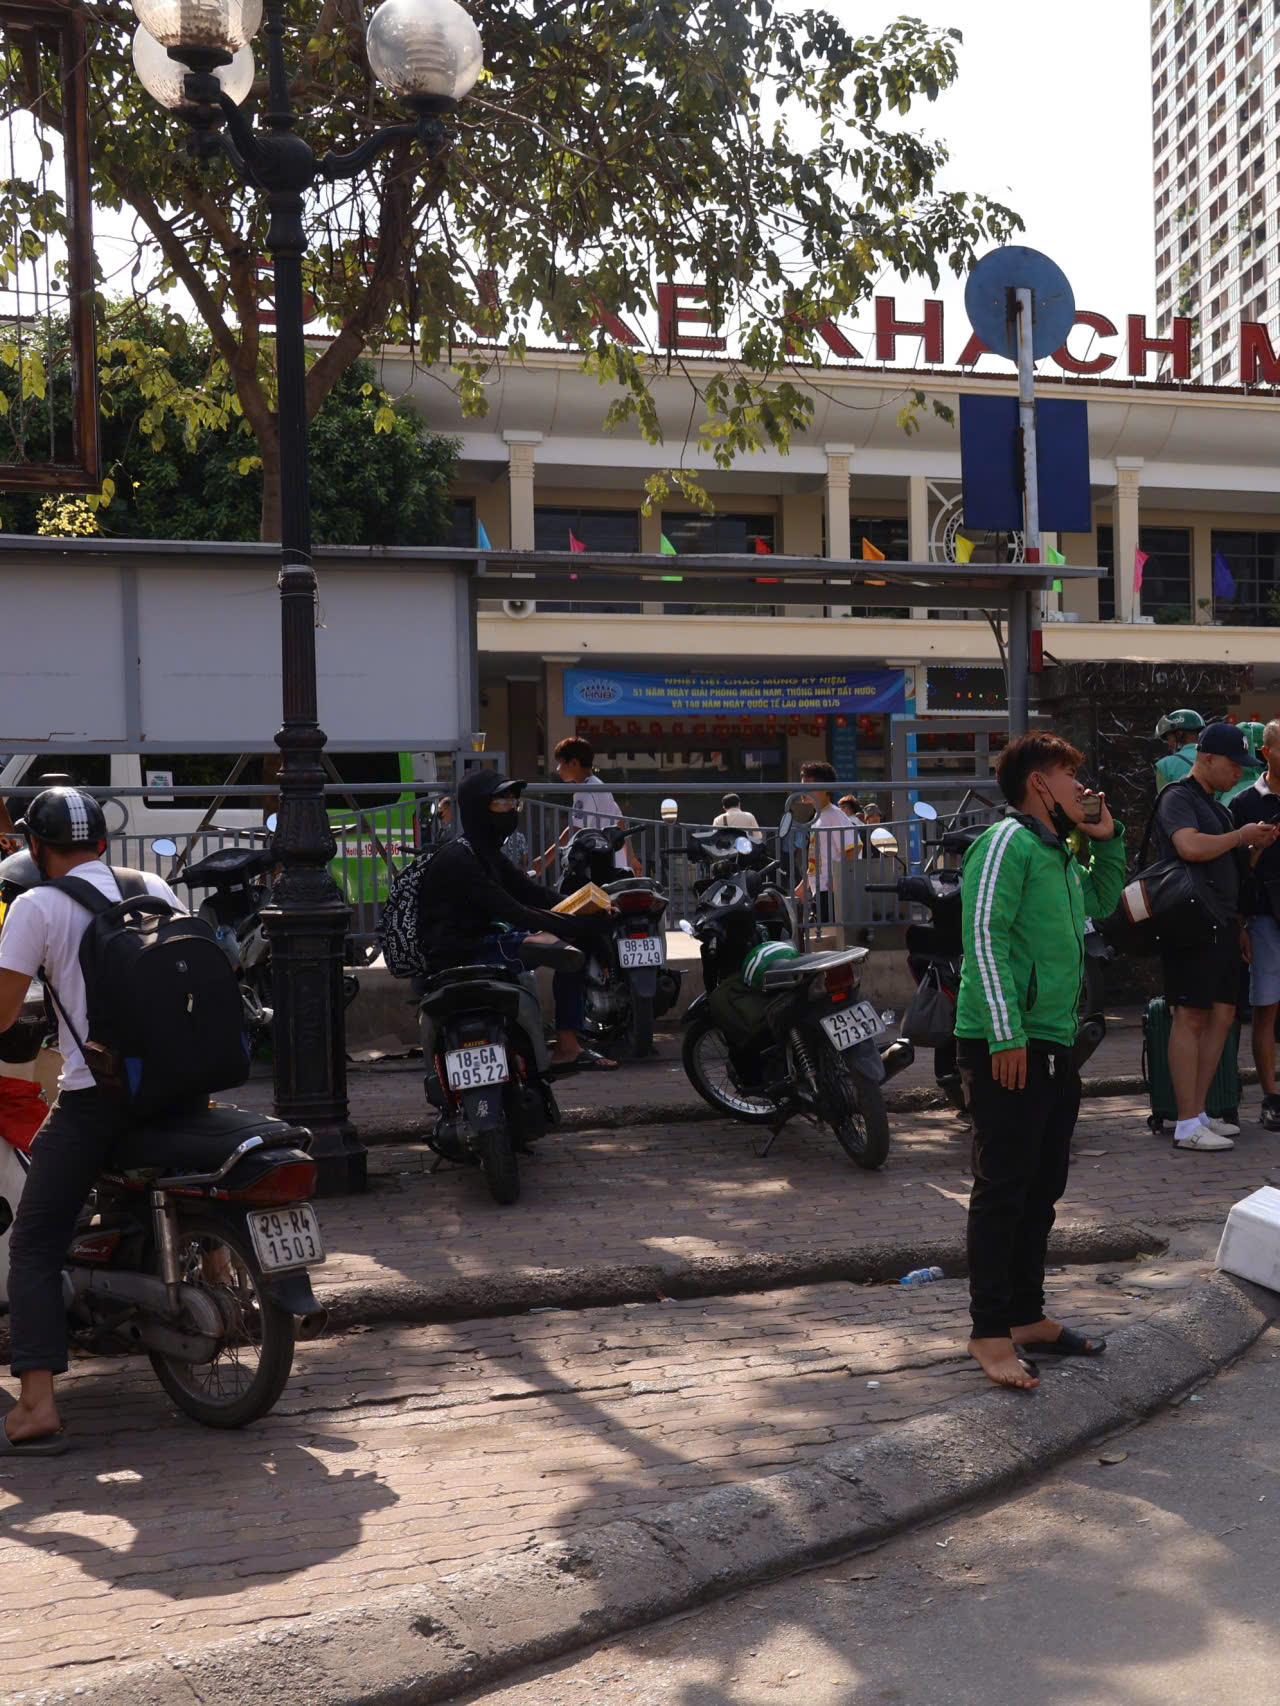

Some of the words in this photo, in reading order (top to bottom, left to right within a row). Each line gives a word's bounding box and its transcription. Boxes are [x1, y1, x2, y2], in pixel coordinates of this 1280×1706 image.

[632, 688, 643, 697] 51
[667, 686, 689, 697] NGÀY
[709, 685, 738, 697] PHÓNG
[722, 698, 745, 709] NGÀY
[624, 939, 656, 952] 98-B3
[623, 951, 661, 966] 872.49
[829, 1006, 868, 1031] 29-L1
[456, 1047, 497, 1069] 18-GA
[452, 1063, 505, 1088] 095.22
[260, 1210, 311, 1240] 29-R4
[269, 1235, 316, 1264] 1503
